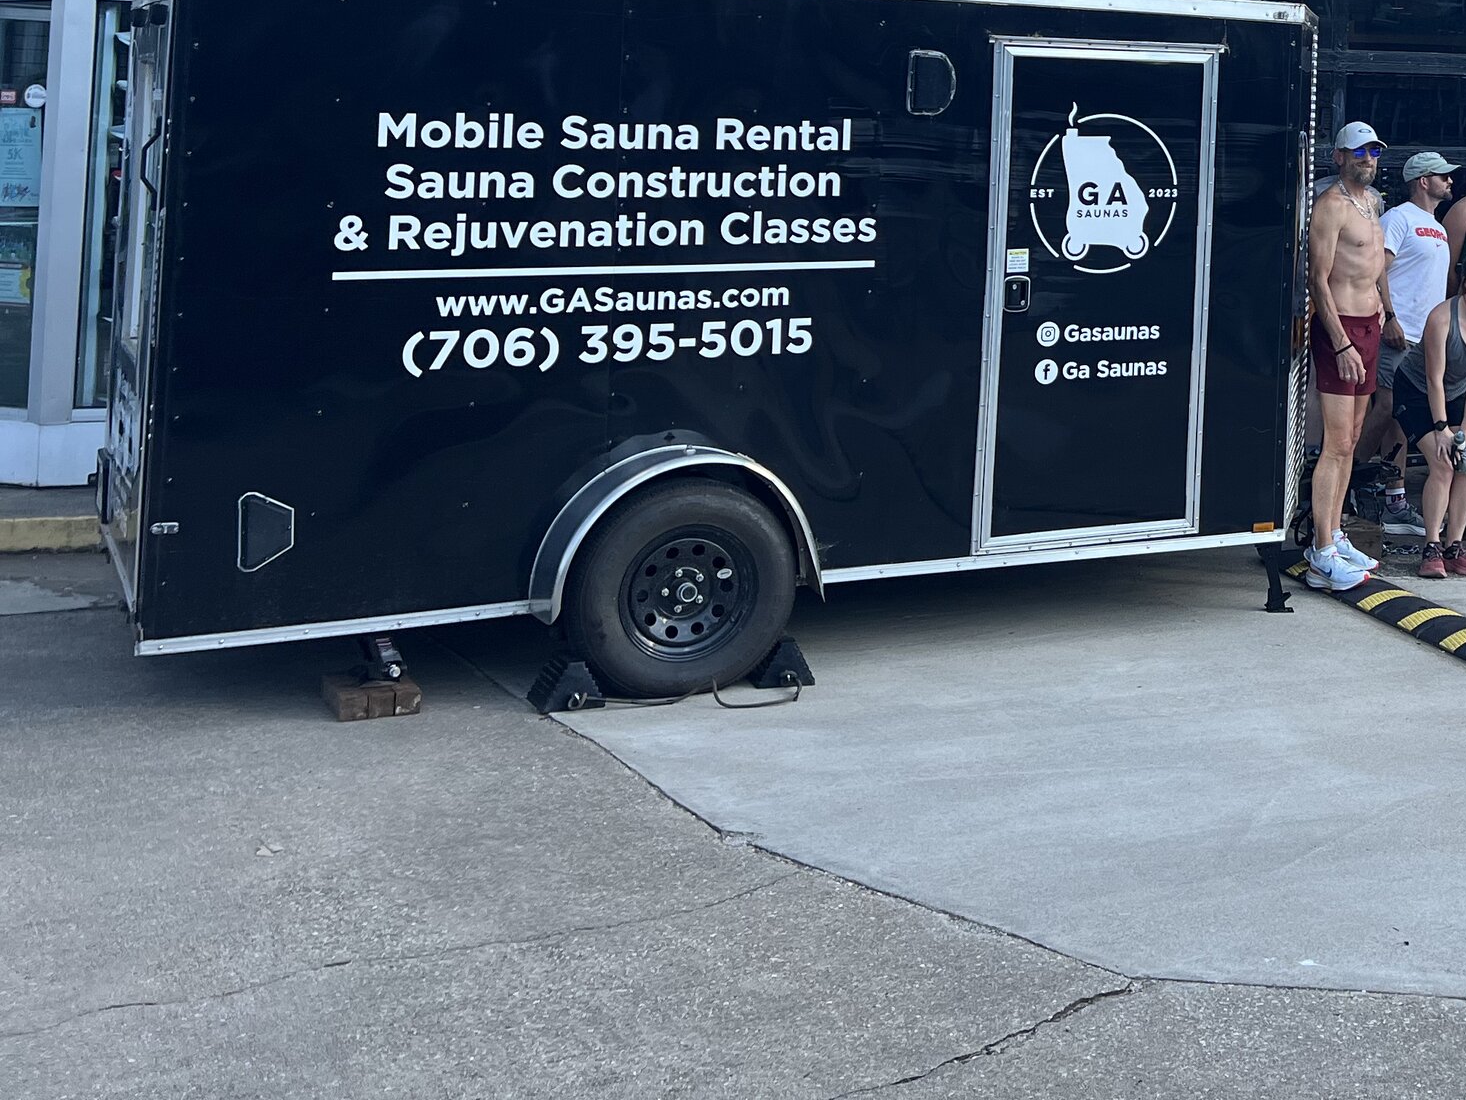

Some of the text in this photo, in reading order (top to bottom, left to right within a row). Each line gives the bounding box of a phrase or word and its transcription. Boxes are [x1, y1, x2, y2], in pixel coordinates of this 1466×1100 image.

[377, 112, 852, 152] Mobile Sauna Rental
[384, 163, 842, 199] Sauna Construction
[1030, 189, 1054, 198] EST
[1077, 181, 1128, 206] GA
[1148, 188, 1178, 199] 2023
[1076, 208, 1129, 219] SAUNAS
[333, 211, 877, 257] & Rejuvenation Classes
[436, 284, 790, 317] www.GASaunas.com
[1064, 323, 1160, 342] Gasaunas
[402, 317, 813, 378] (706) 395-5015
[1062, 360, 1168, 379] Ga Saunas
